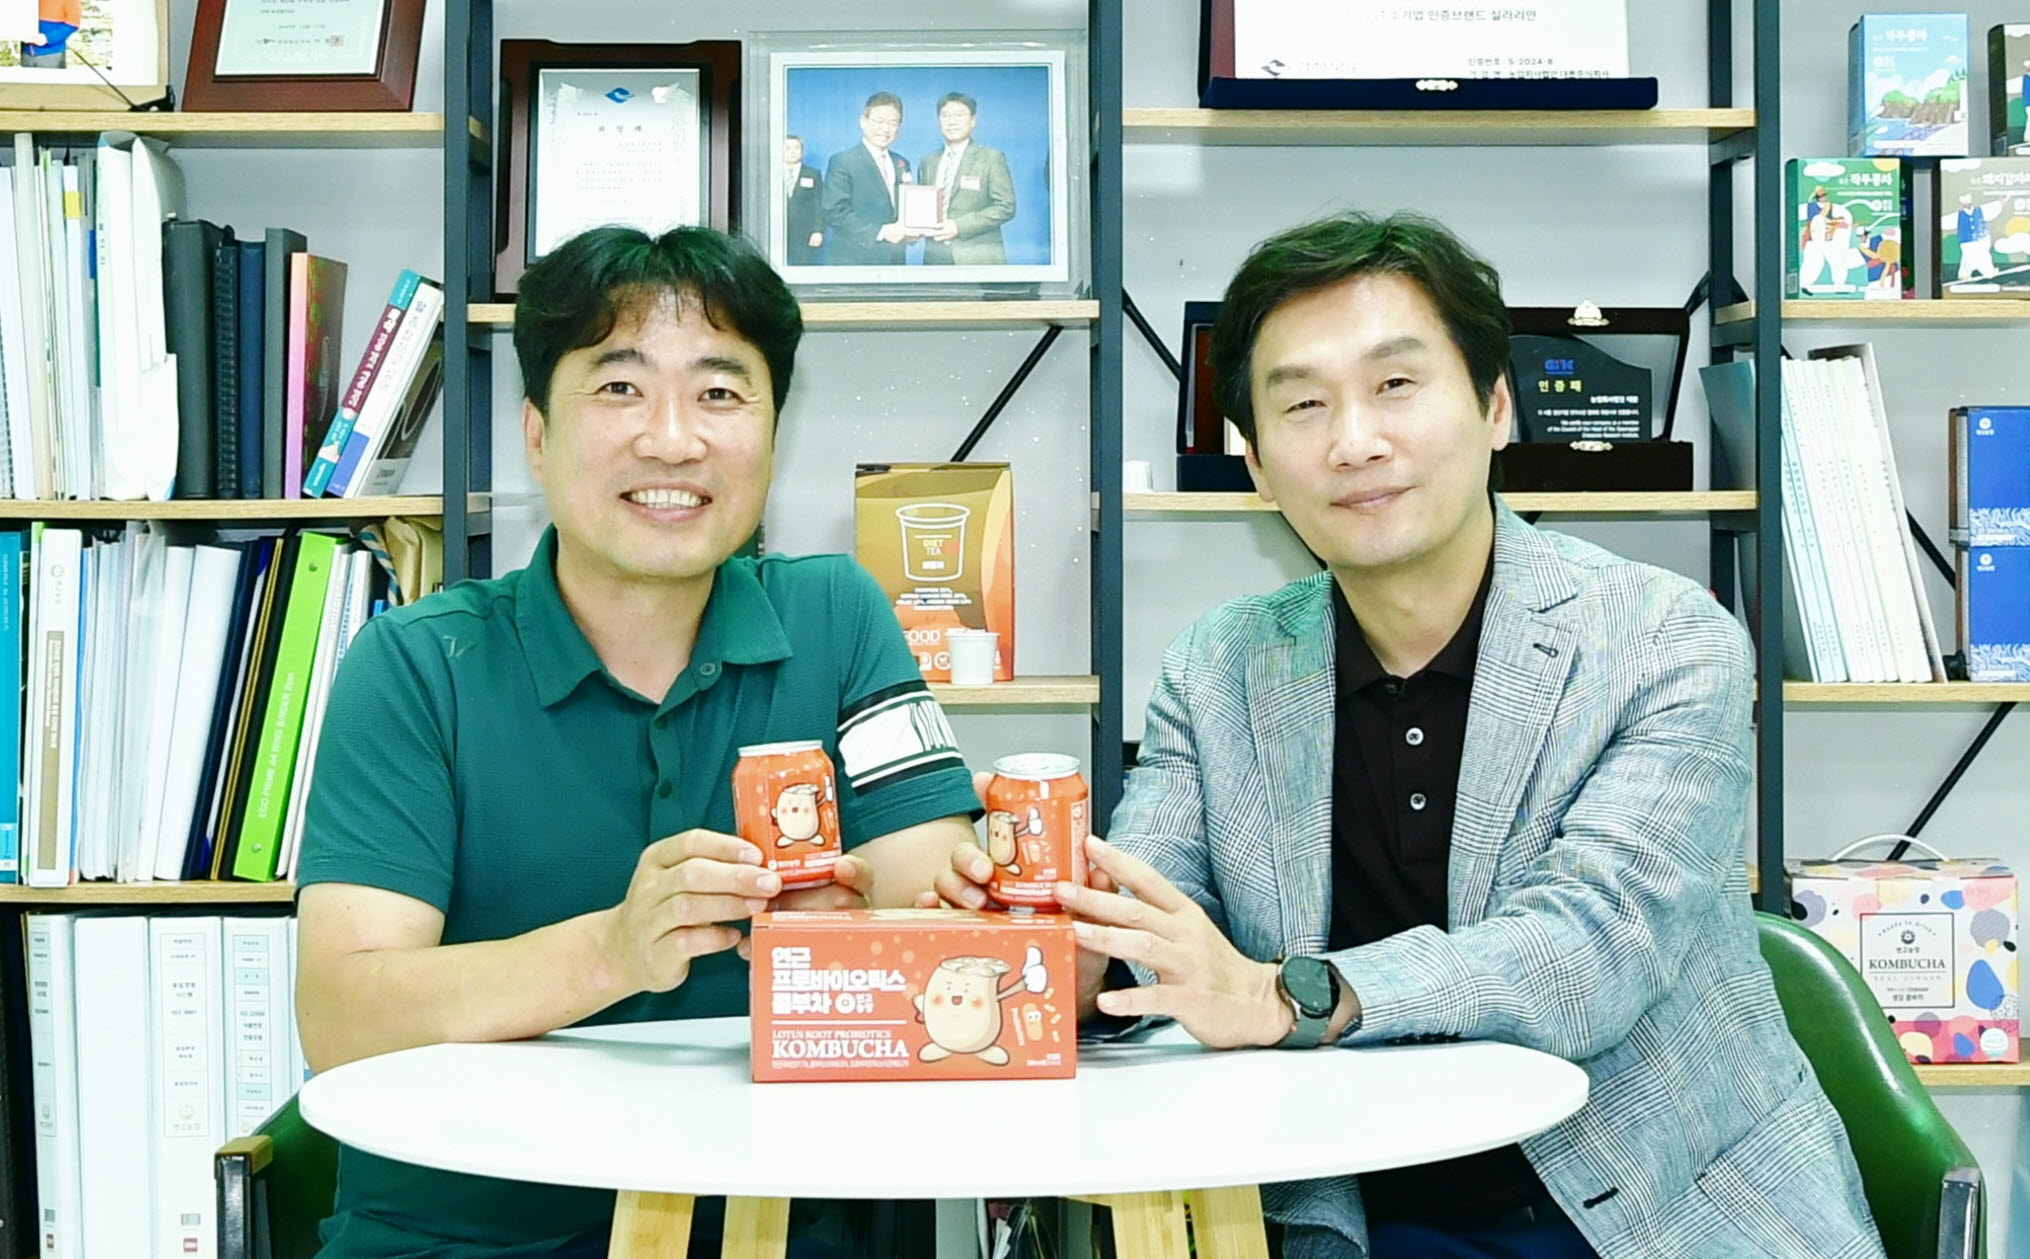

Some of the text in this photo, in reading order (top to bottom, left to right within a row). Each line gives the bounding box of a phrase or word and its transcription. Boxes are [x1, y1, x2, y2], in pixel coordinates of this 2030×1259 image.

[1428, 10, 1487, 21] 인증브랜드
[1491, 9, 1537, 21] 실라리안
[923, 539, 945, 548] DIET
[926, 547, 942, 556] TEA
[771, 946, 812, 969] 연근
[1868, 958, 1946, 970] KOMBUCHA
[772, 969, 907, 992] 프로바이오틱스
[771, 992, 833, 1015] 콤부차
[772, 1030, 804, 1039] LOTUS
[805, 1030, 833, 1039] ROOT
[772, 1039, 910, 1059] KOMBUCHA
